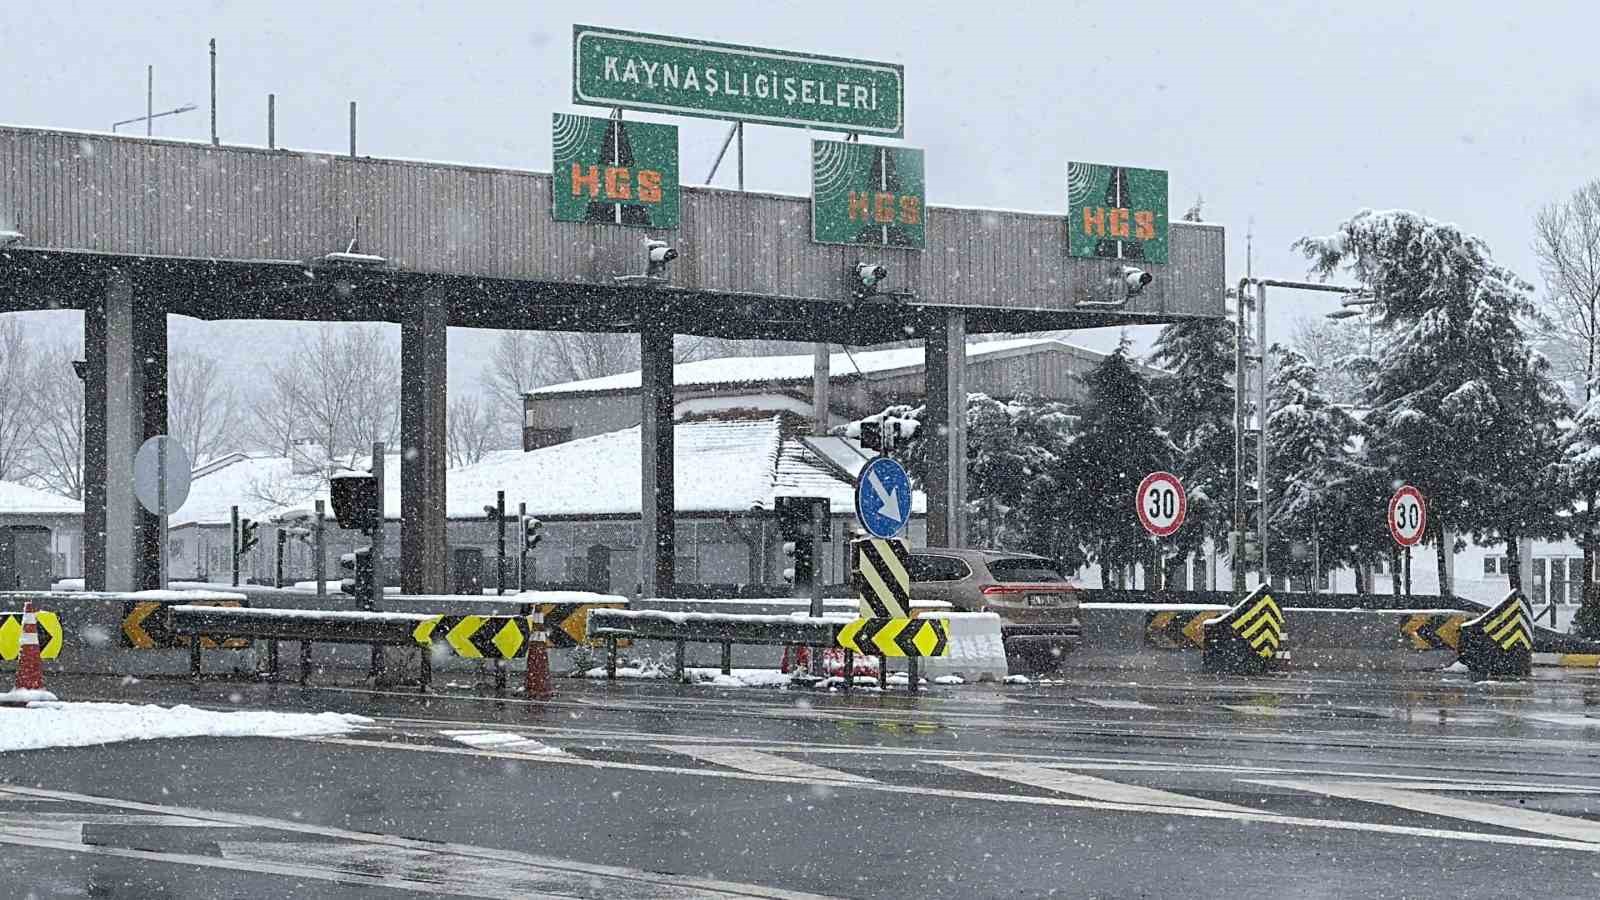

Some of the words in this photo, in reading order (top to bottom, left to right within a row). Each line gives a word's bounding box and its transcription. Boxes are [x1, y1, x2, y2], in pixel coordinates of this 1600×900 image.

[571, 162, 662, 203] HGS
[848, 191, 921, 225] HGS
[1083, 207, 1155, 240] HGS
[1149, 488, 1174, 519] 30
[1397, 503, 1419, 529] 30
